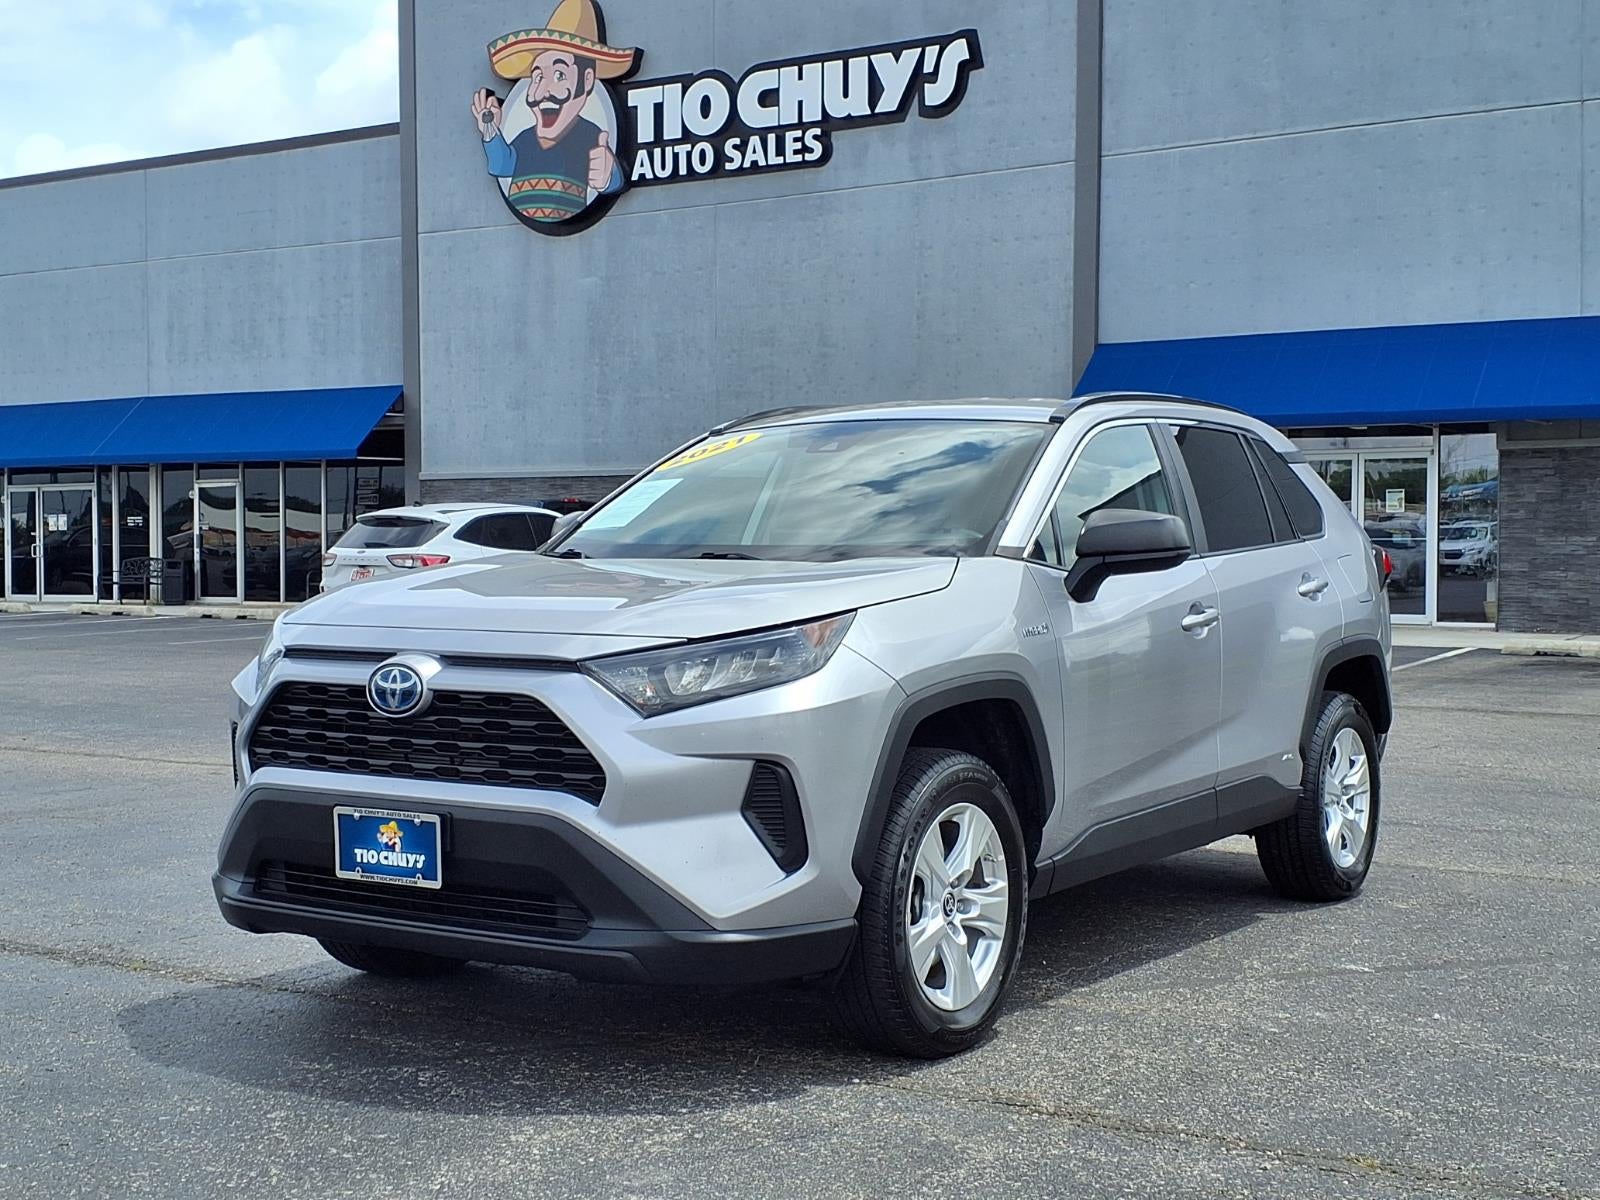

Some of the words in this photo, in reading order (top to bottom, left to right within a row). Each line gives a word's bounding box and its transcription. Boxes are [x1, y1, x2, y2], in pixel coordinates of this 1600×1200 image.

[627, 77, 731, 144] TIO
[736, 37, 970, 130] CHUY'S
[631, 141, 714, 182] AUTO
[724, 127, 823, 171] SALES
[354, 848, 379, 864] TIO
[379, 850, 426, 869] CHUY'S
